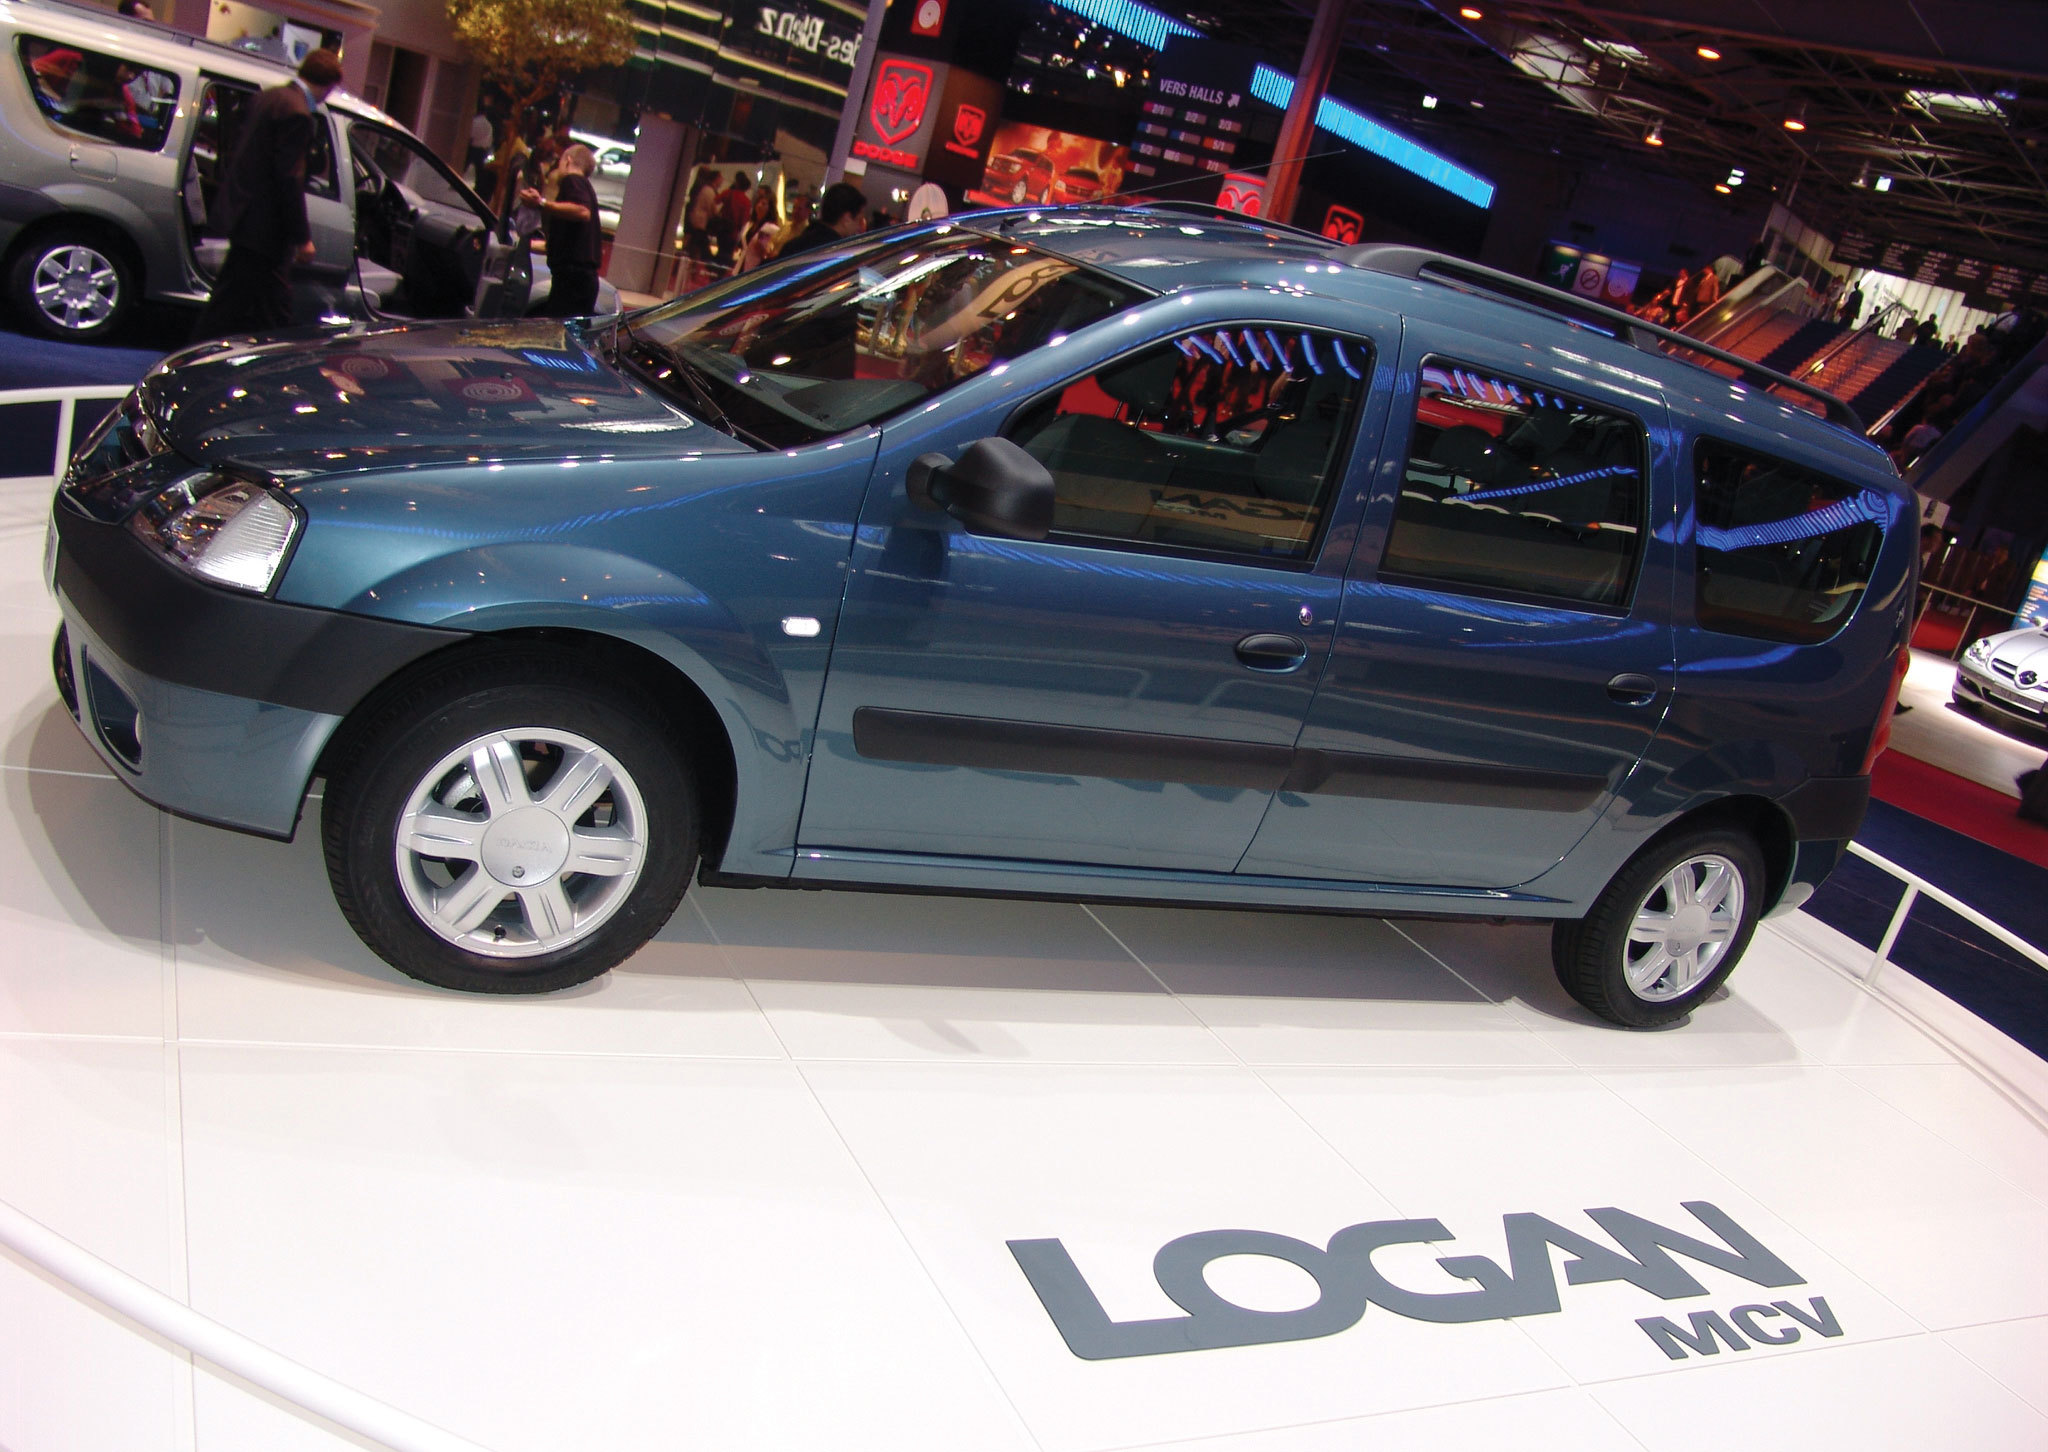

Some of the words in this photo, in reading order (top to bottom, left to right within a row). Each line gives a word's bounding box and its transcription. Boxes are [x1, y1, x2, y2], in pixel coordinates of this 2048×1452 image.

[1159, 79, 1187, 97] VERS
[1188, 85, 1224, 105] HALLS
[1005, 1200, 1807, 1361] LOGAN
[1633, 1296, 1845, 1361] MCV
